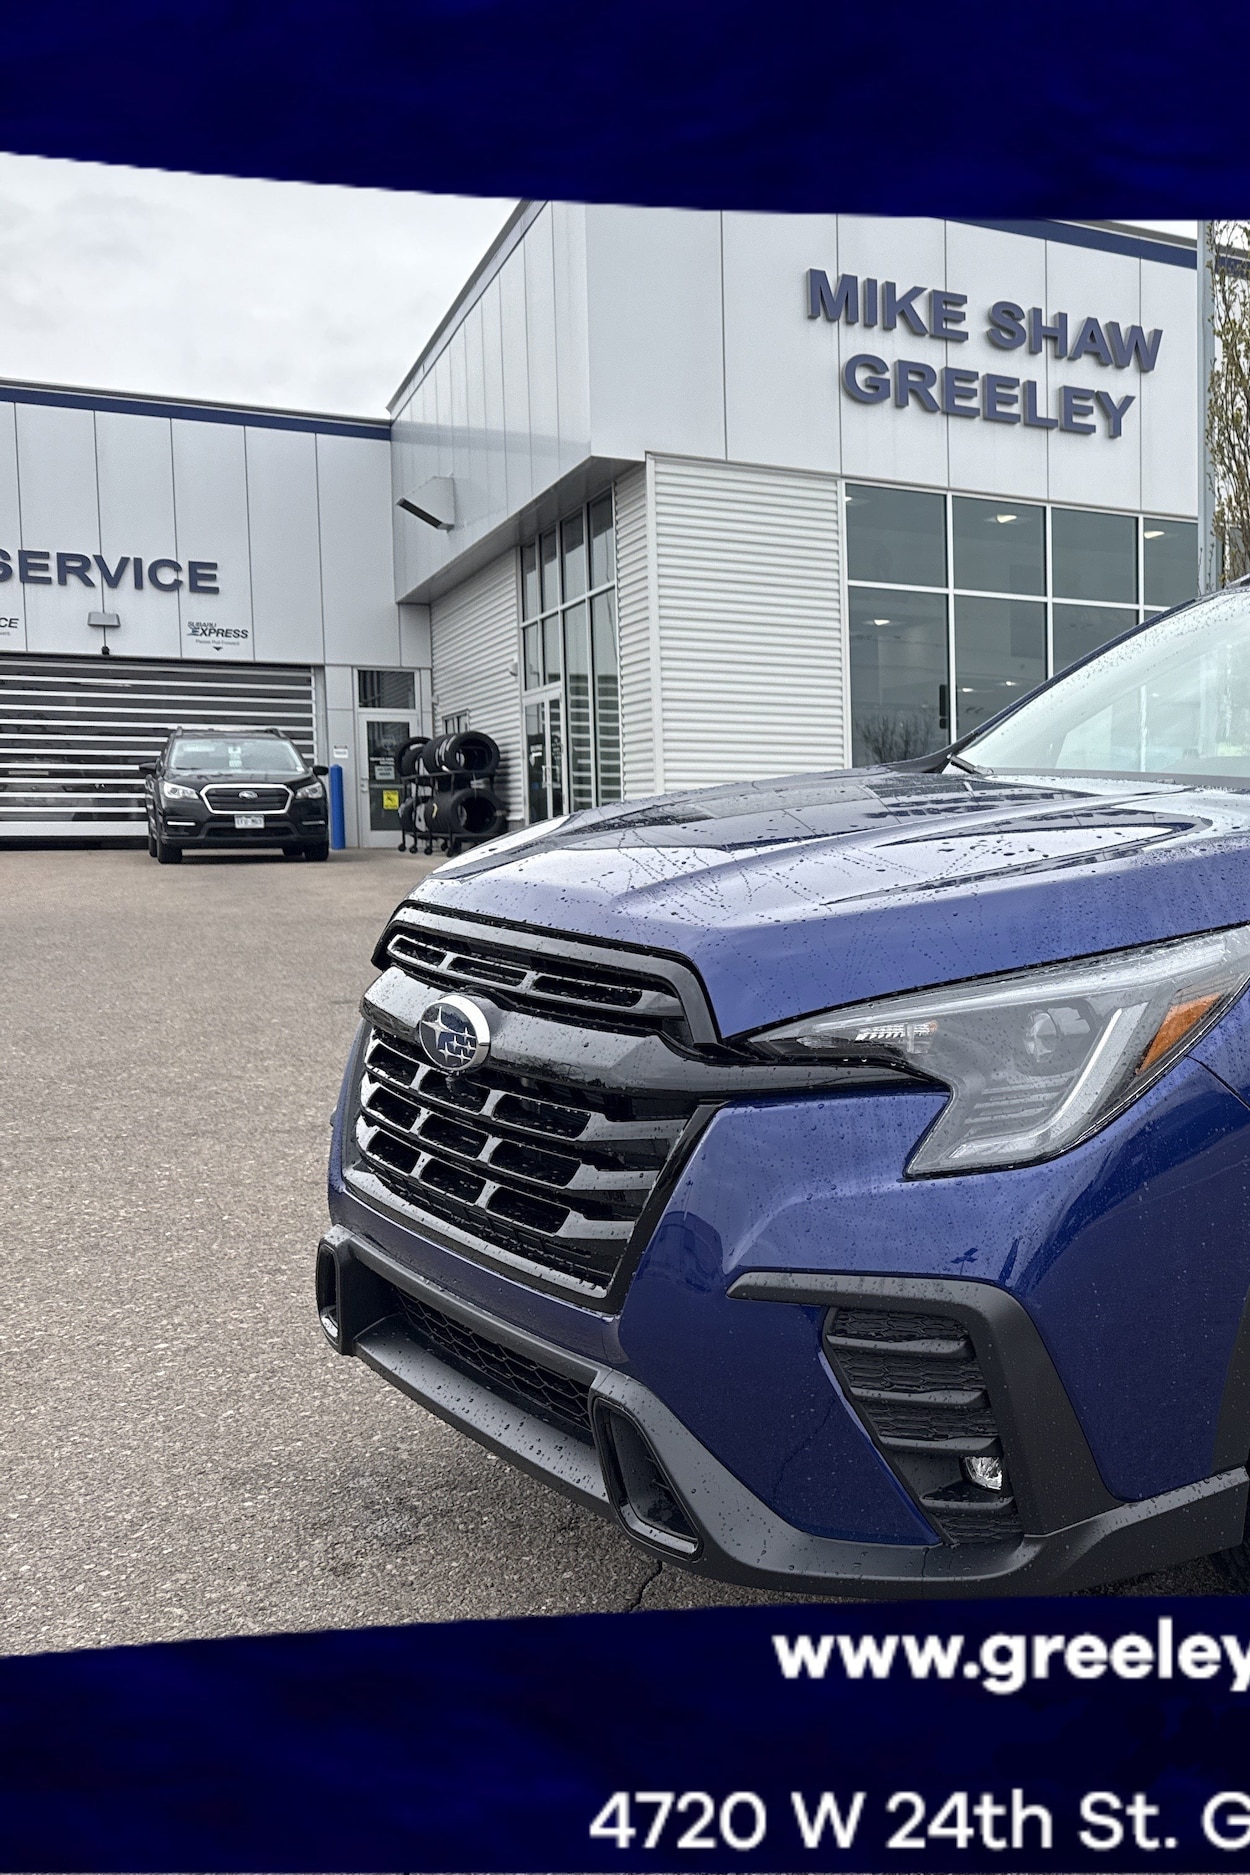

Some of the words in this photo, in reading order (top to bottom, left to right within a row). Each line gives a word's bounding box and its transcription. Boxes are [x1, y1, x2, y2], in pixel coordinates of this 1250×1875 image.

[806, 267, 969, 343] MIKE
[986, 300, 1164, 373] SHAW
[841, 353, 1136, 439] GREELEY
[187, 627, 249, 639] EXPRESS
